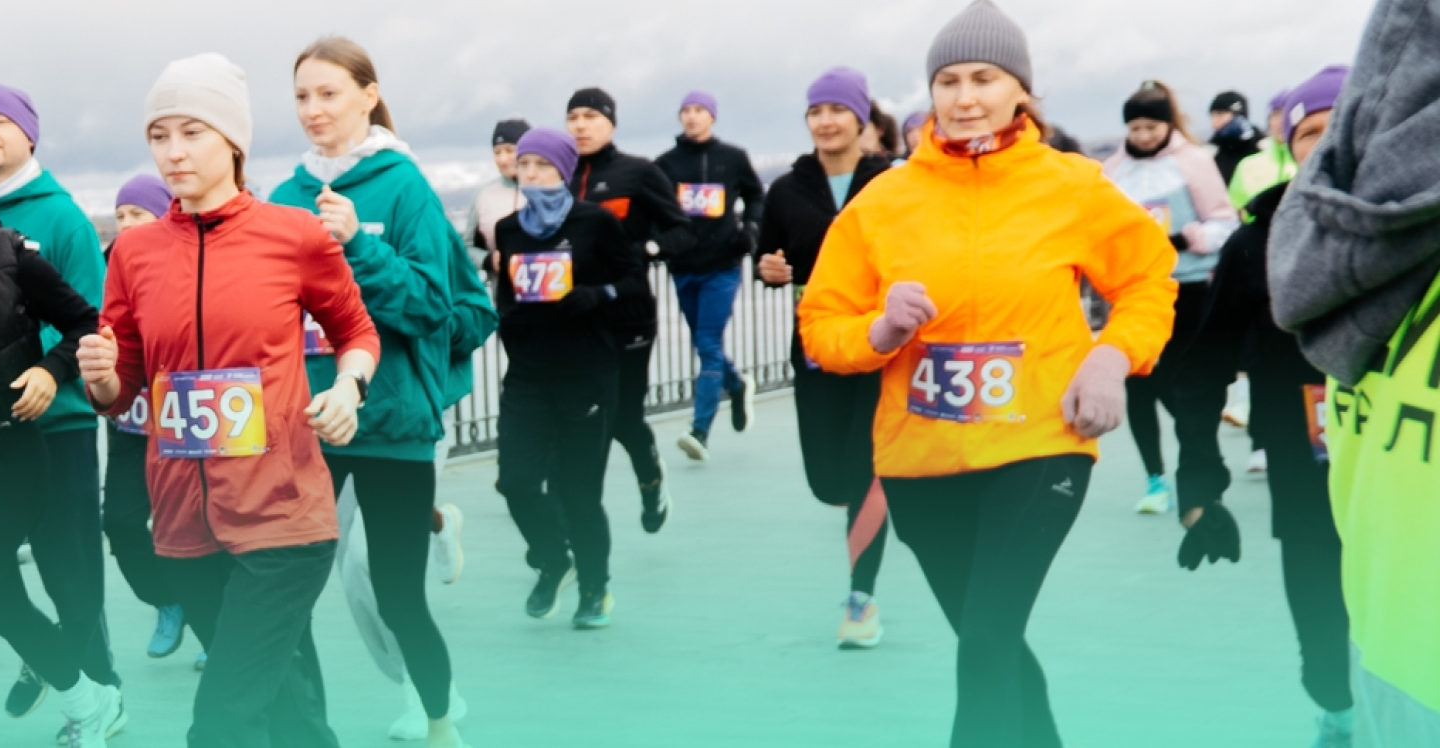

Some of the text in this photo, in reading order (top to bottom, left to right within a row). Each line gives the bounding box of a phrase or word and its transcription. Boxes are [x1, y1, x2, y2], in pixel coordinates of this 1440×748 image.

[514, 262, 565, 293] 472
[912, 357, 1015, 407] 438
[160, 386, 254, 440] 459
